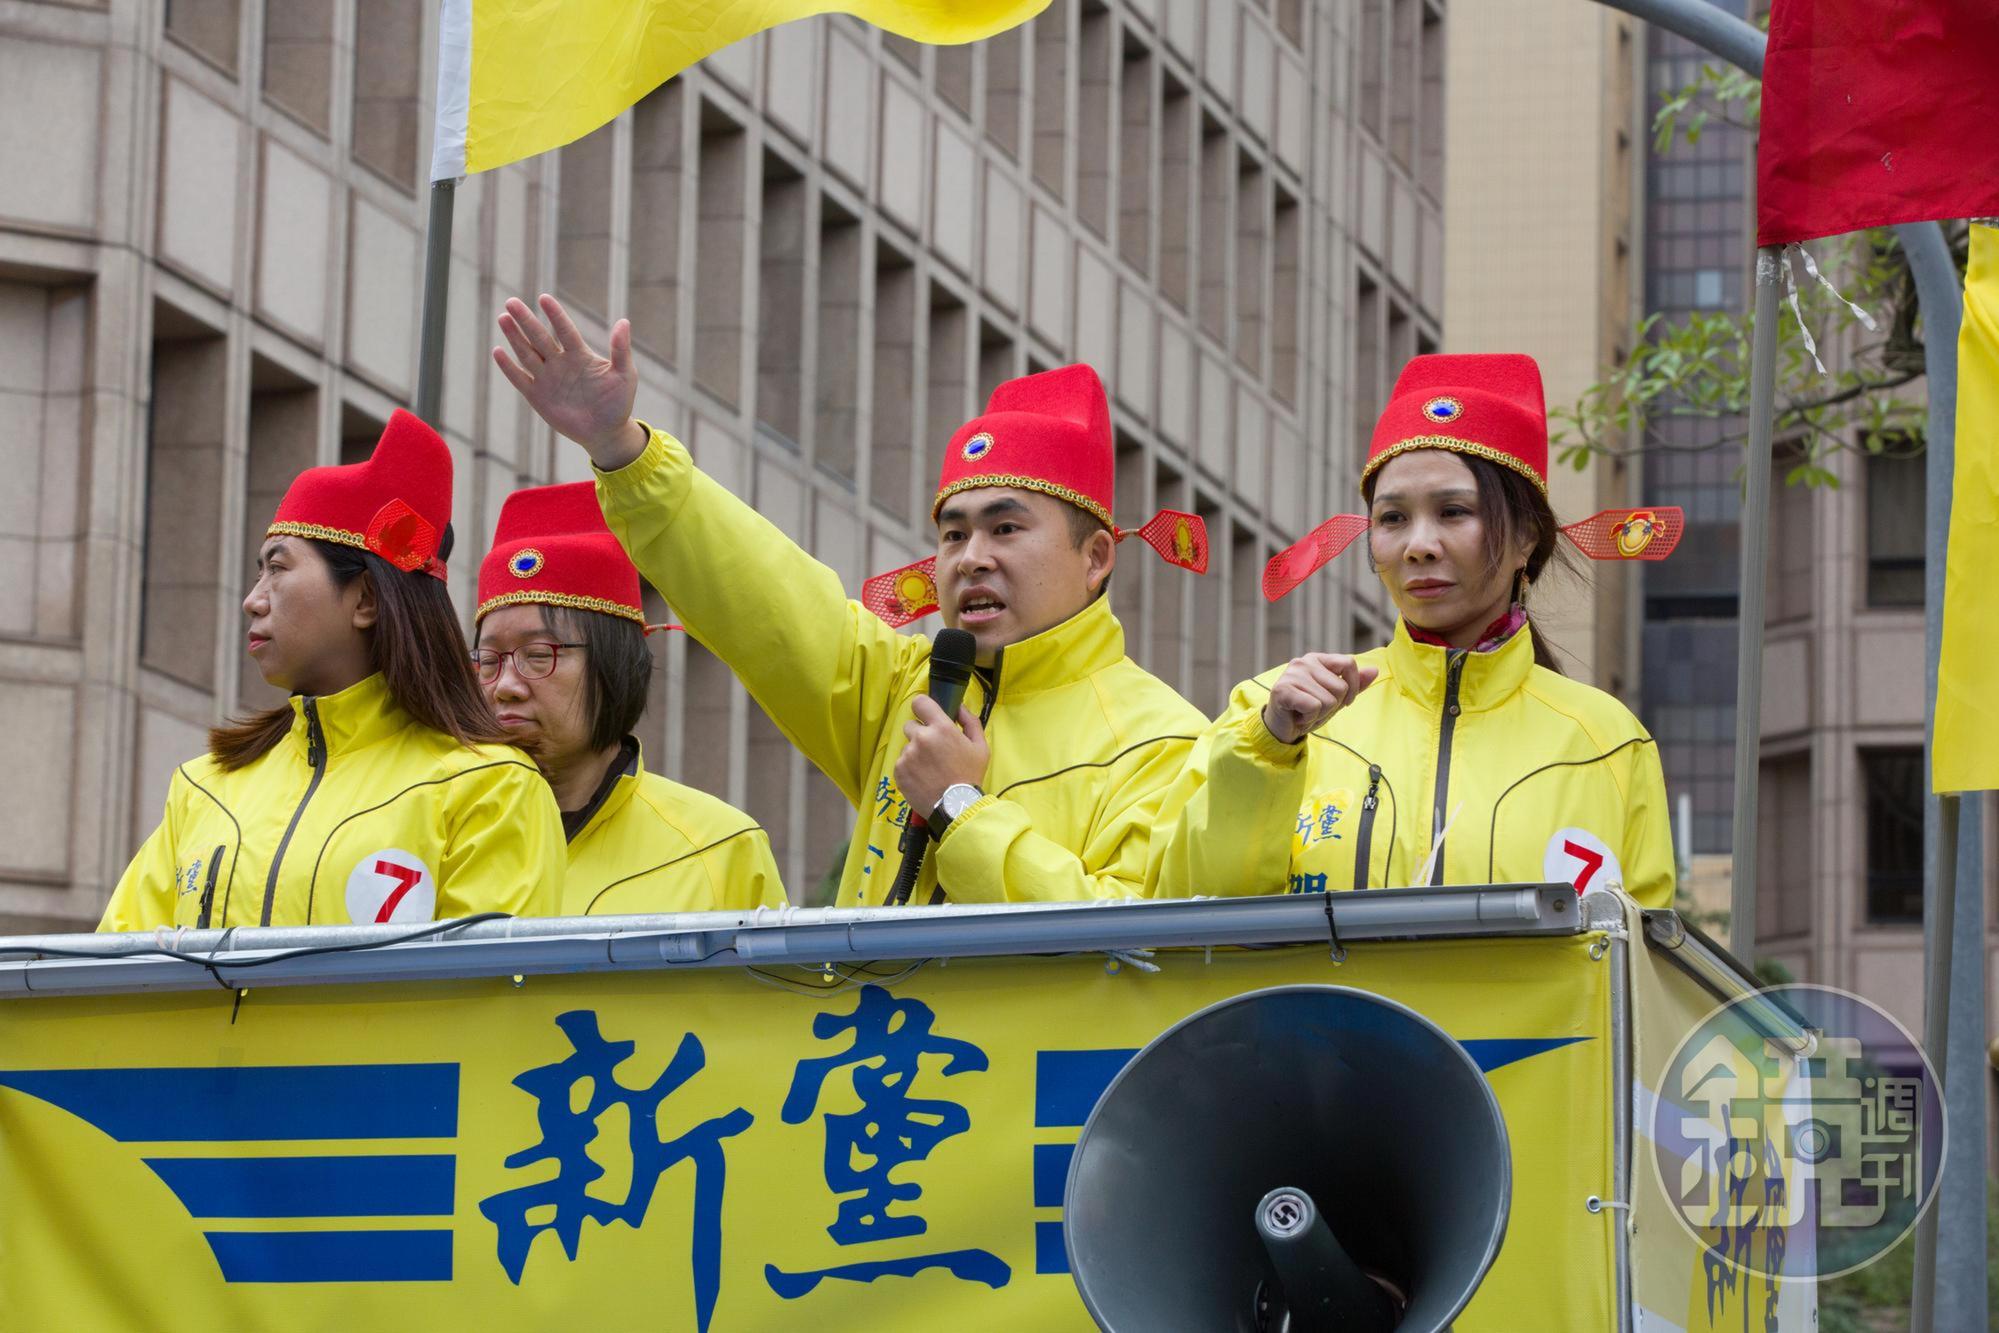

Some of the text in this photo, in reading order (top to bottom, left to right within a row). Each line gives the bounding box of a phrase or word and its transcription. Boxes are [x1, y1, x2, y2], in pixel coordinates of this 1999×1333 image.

[375, 860, 422, 924] 7
[1564, 839, 1604, 897] 7
[479, 984, 1012, 1333] 新黨
